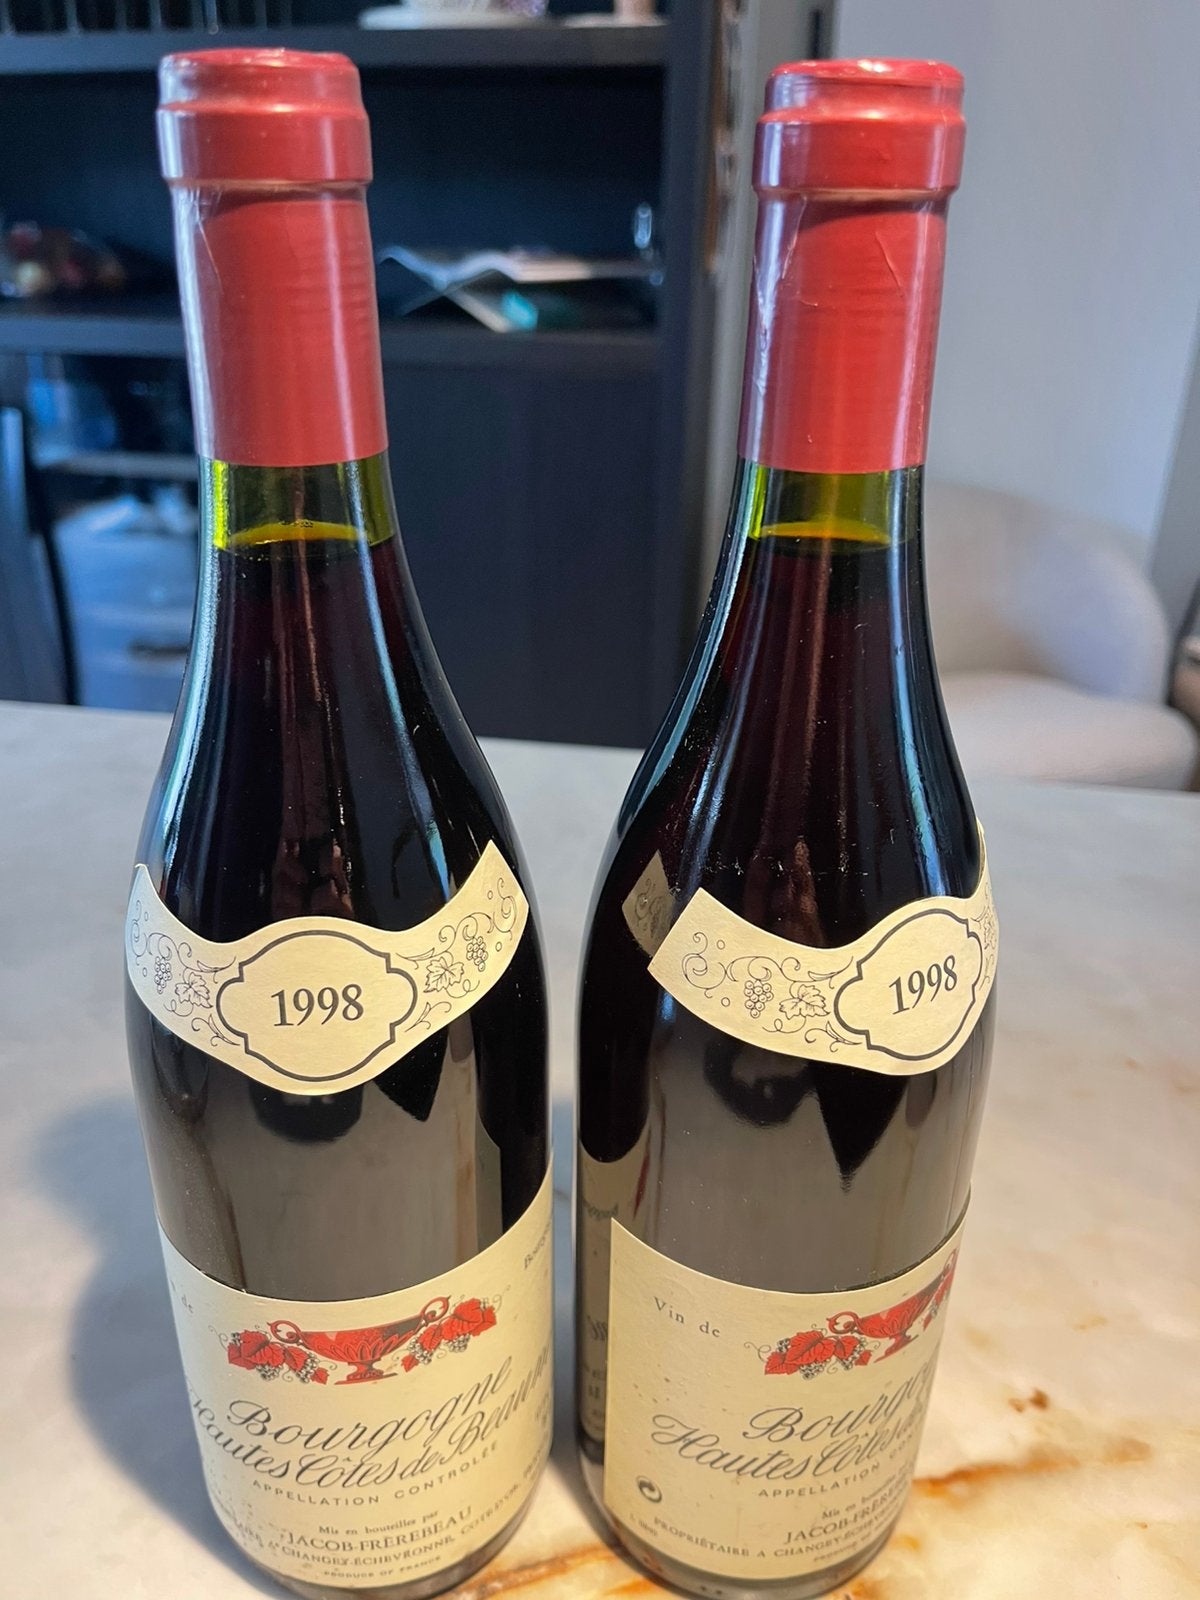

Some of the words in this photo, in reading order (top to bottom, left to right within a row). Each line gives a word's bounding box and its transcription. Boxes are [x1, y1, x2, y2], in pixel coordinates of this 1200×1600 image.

[270, 983, 365, 1028] 1998
[888, 954, 959, 1016] 1998
[654, 1296, 685, 1324] Vin
[699, 1321, 720, 1338] de
[227, 1355, 513, 1464] Bourgogne
[295, 1451, 400, 1489] Côtes
[400, 1445, 440, 1481] de
[651, 1413, 814, 1481] Hautes
[252, 1478, 380, 1506] APPELLATION
[757, 1461, 881, 1499] APPELLATION
[318, 1525, 339, 1535] Mis
[364, 1518, 416, 1535] bouteilles
[421, 1510, 439, 1524] par
